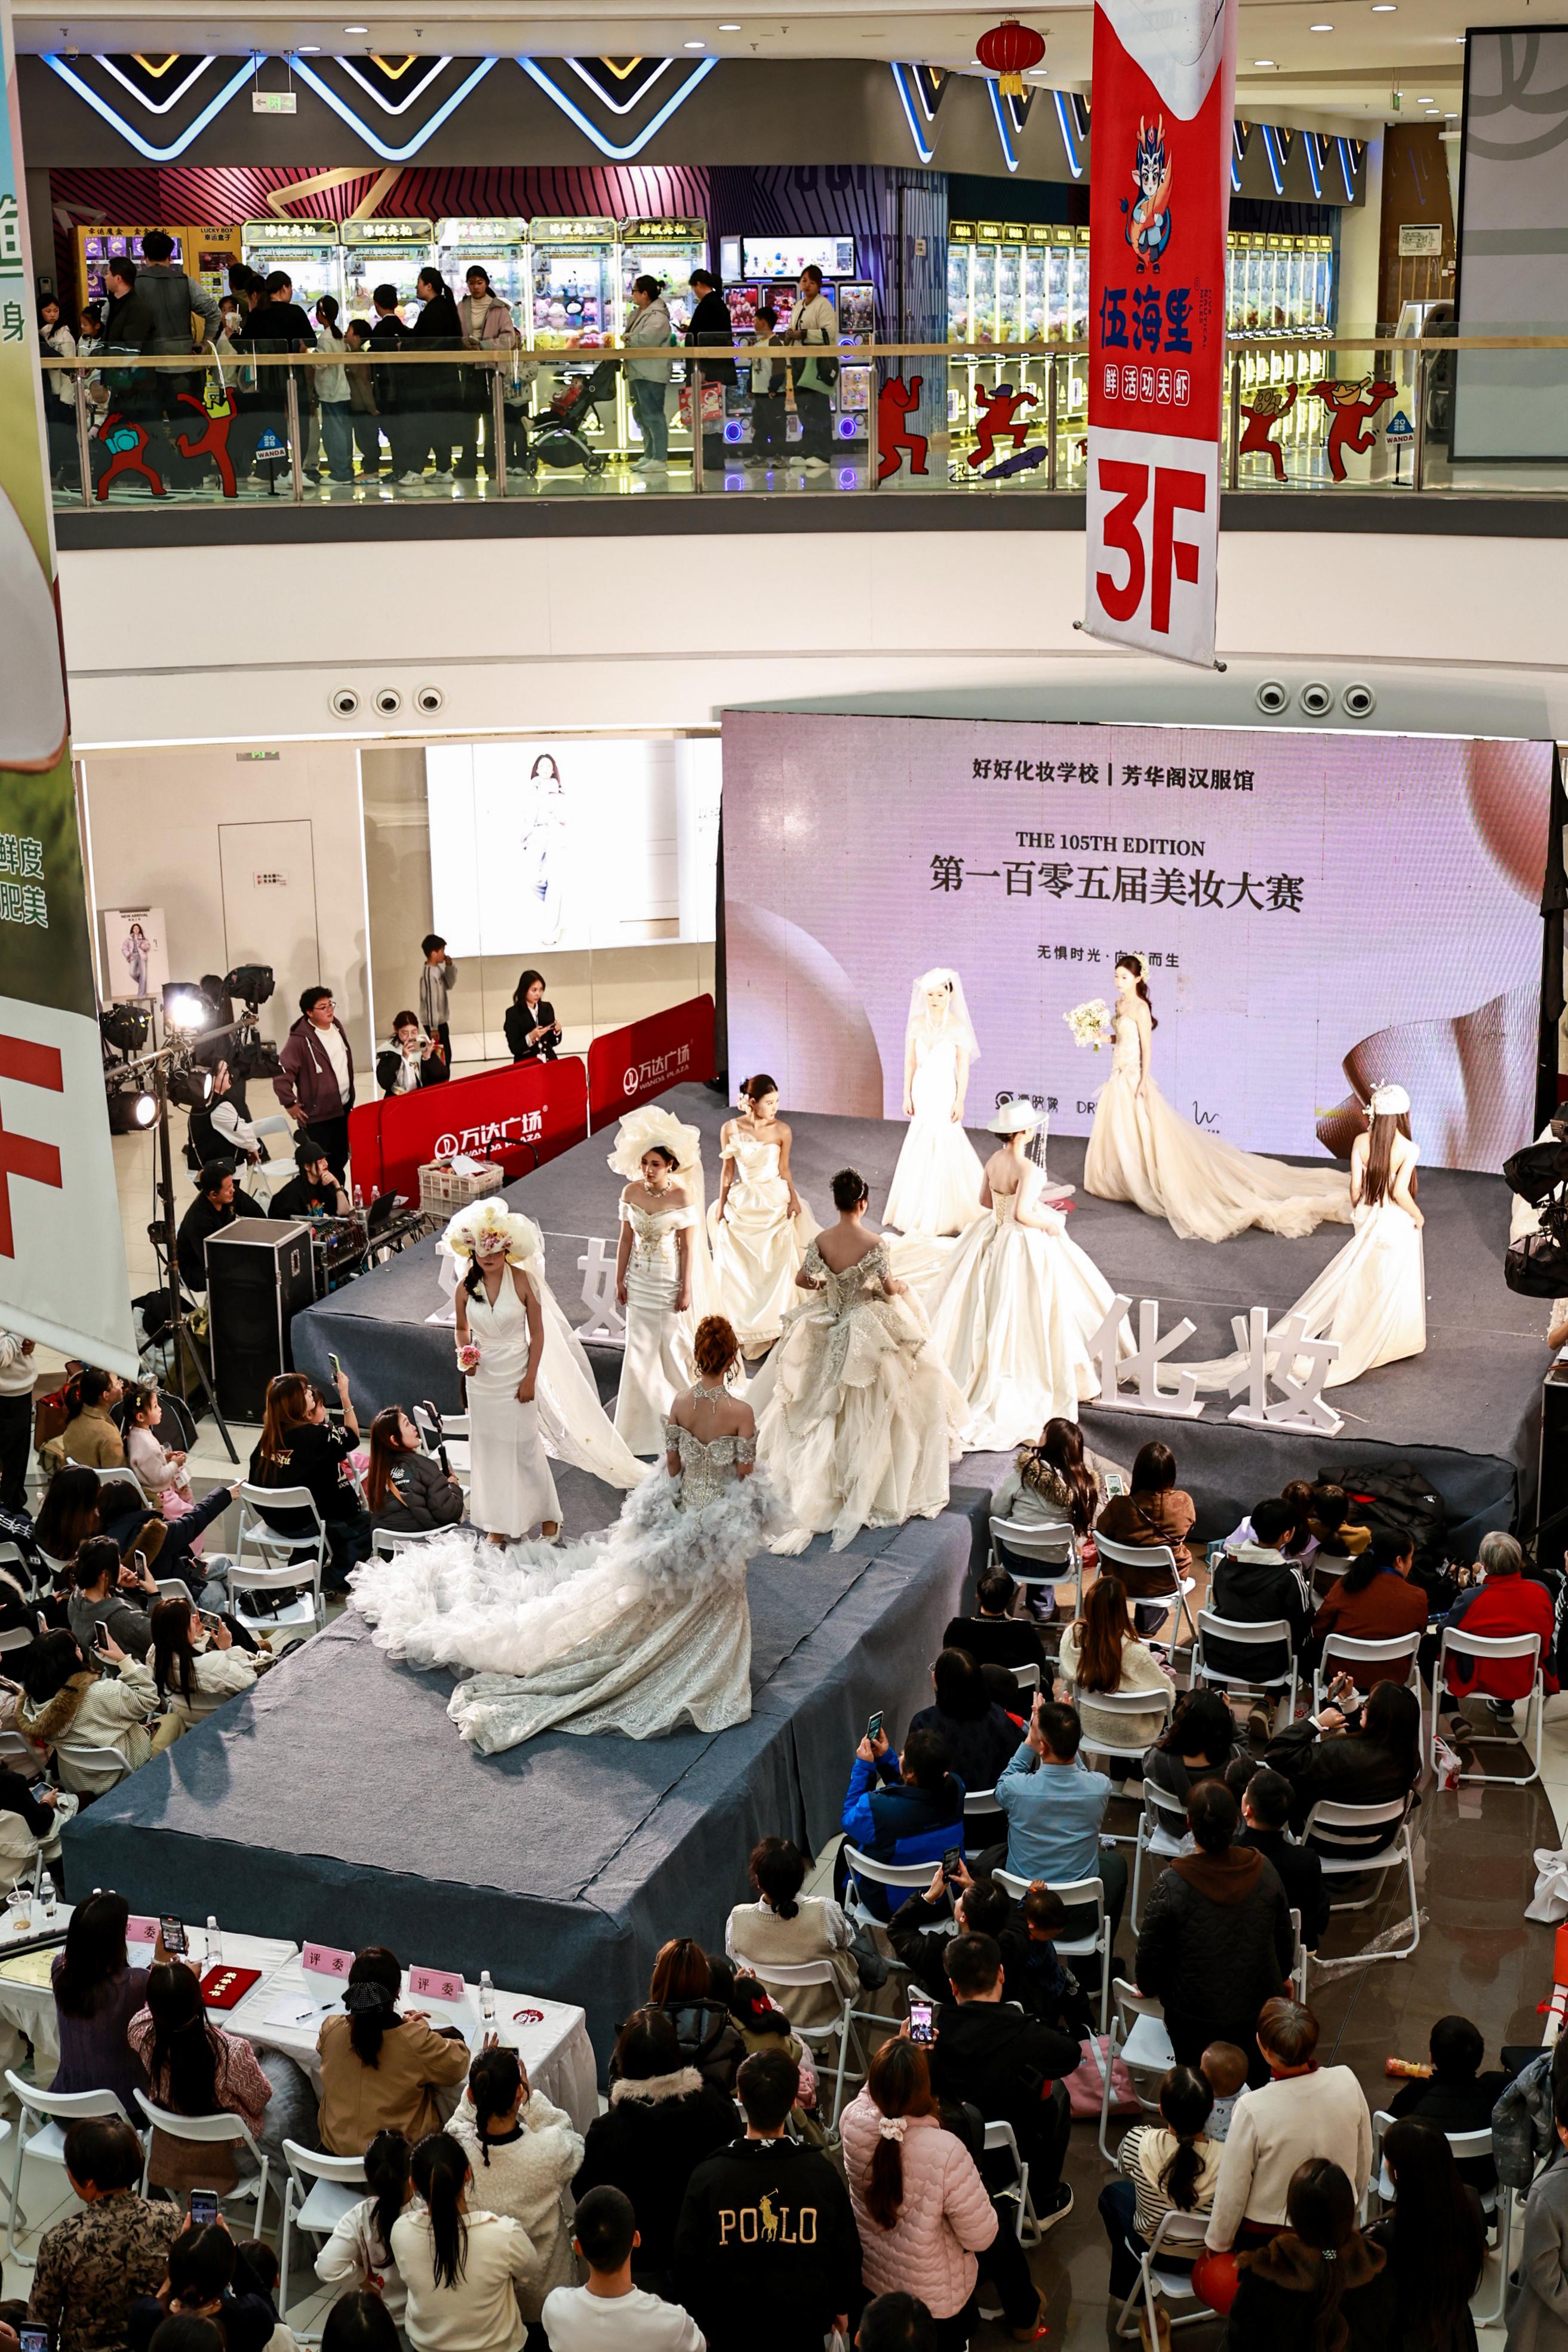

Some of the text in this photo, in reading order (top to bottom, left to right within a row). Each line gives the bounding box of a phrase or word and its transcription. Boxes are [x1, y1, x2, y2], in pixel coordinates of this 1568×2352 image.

[2, 301, 26, 342] 身
[1105, 367, 1188, 401] 鲜活功夫虾
[257, 449, 285, 459] WANDA
[1386, 435, 1414, 444] WANDA
[1096, 458, 1206, 634] 3F
[972, 758, 1255, 792] 好好化妆学校 芳华阁汉服馆
[1016, 831, 1206, 857] THE 105TH EDITION
[929, 854, 1305, 914] 第一百零五届美妆大赛
[638, 1044, 690, 1083] 万达广场
[640, 1063, 690, 1090] WANDA PLAZA
[459, 1110, 543, 1151] 万达广场
[1087, 1293, 1342, 1431] 化妆
[310, 1952, 344, 1972] 评委
[418, 1977, 454, 1997] 评委
[718, 2207, 817, 2246] POLO
